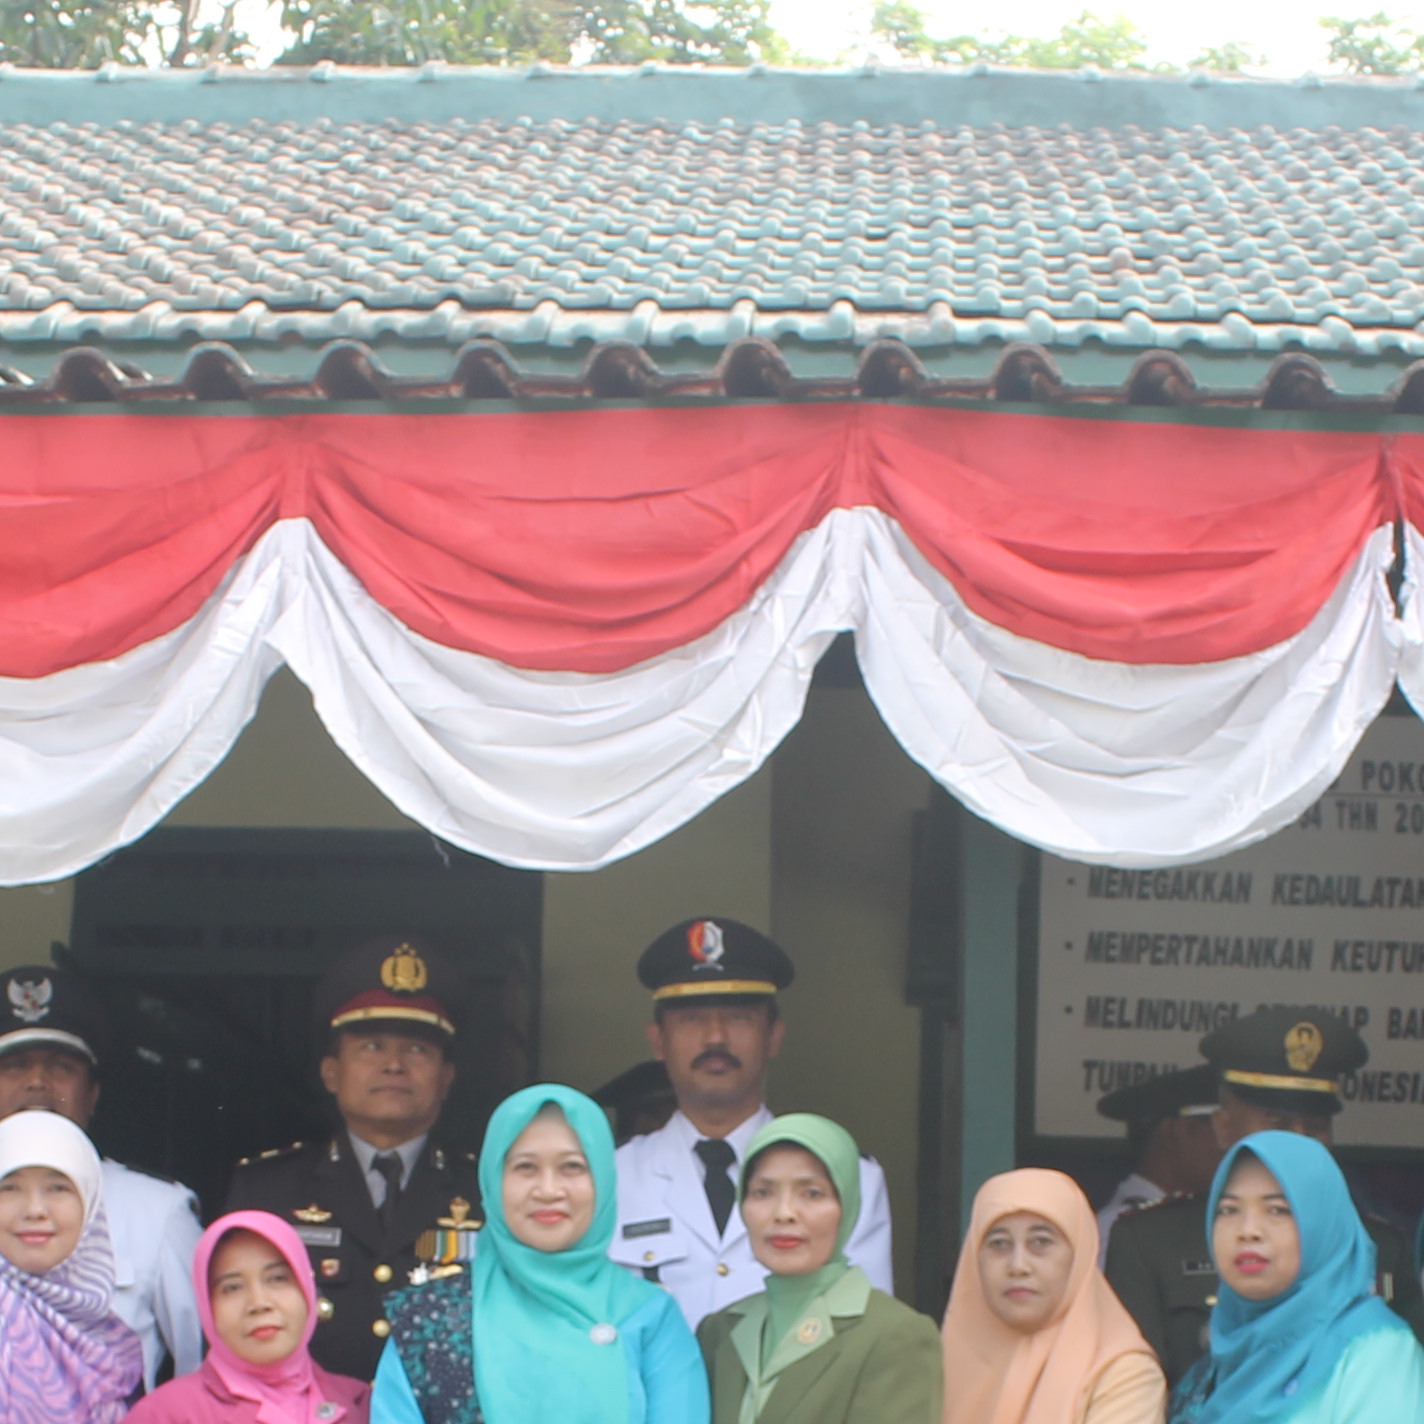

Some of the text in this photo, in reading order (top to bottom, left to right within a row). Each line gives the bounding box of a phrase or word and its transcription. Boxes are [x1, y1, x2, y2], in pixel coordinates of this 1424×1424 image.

[1335, 800, 1379, 831] THN
[1087, 867, 1253, 903] MENEGAKKAN
[1085, 931, 1313, 970] MEMPERTAHANKAN
